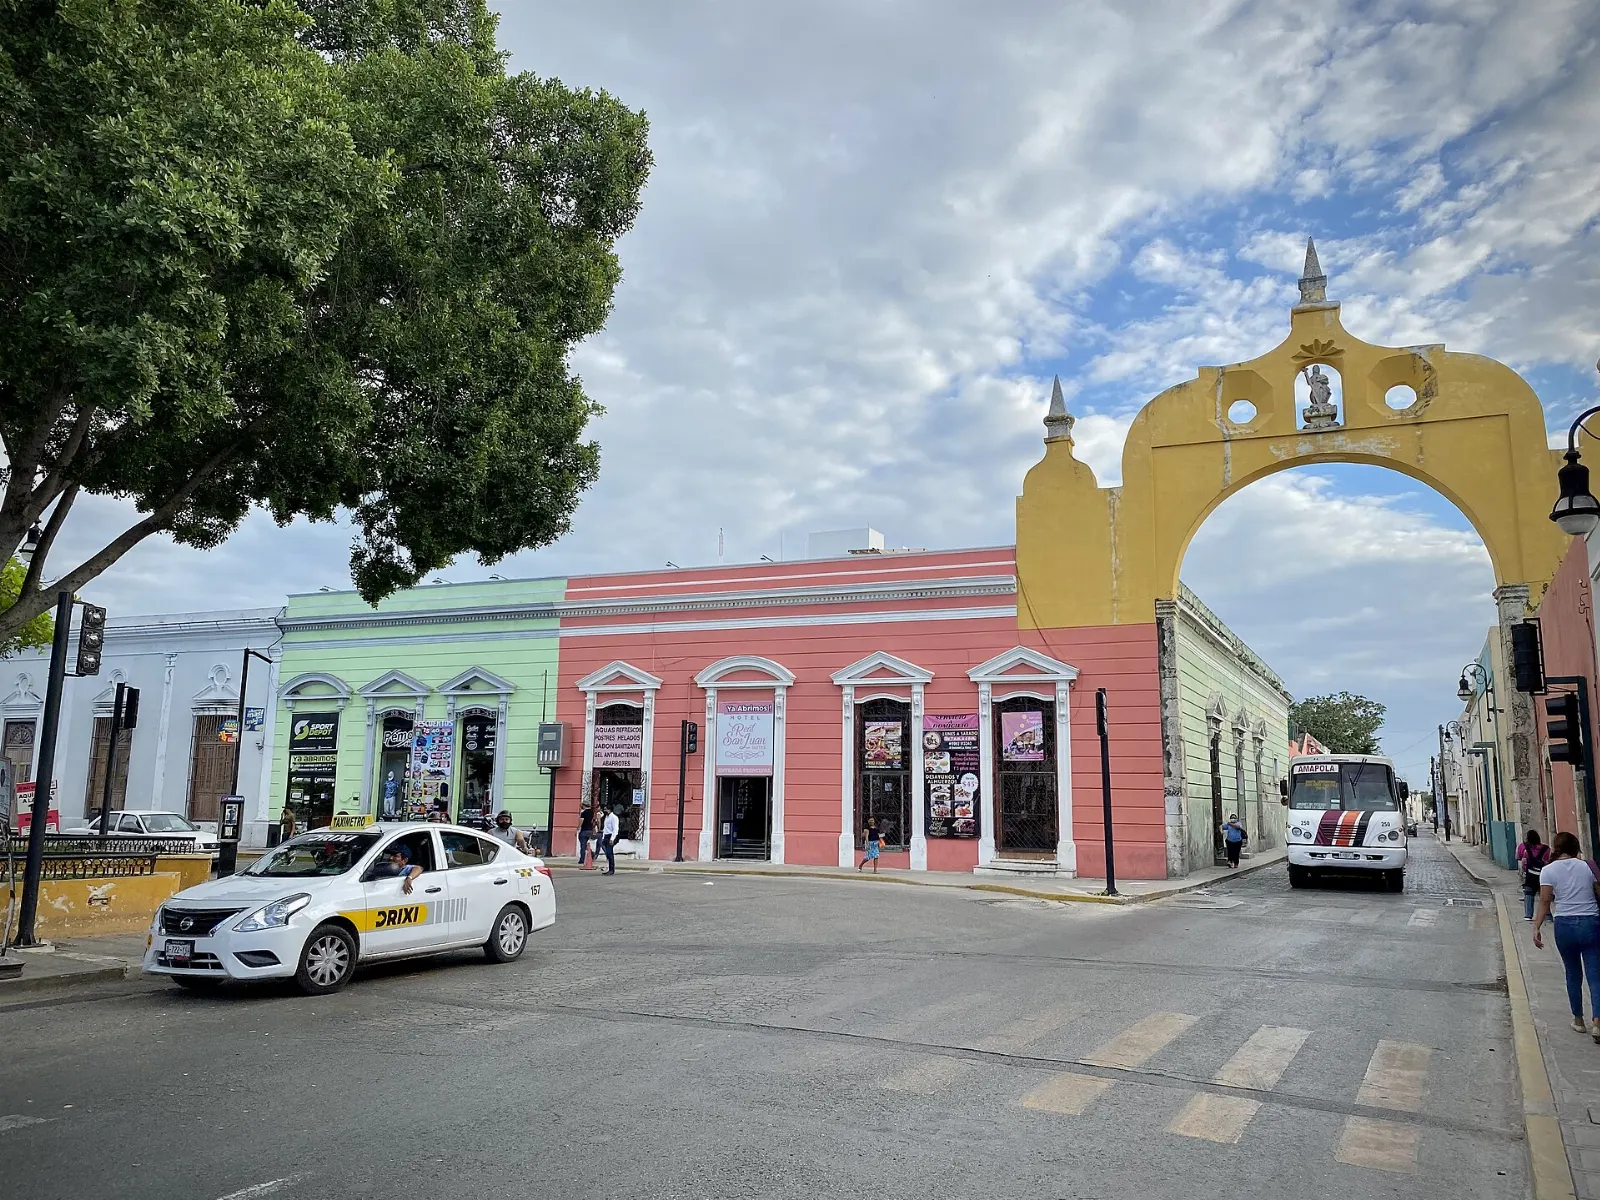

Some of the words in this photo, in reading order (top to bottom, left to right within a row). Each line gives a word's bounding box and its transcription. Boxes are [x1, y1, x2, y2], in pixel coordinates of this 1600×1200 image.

[334, 816, 366, 827] TAXIMETRO
[530, 885, 541, 896] 157
[375, 906, 419, 928] DRIXI
